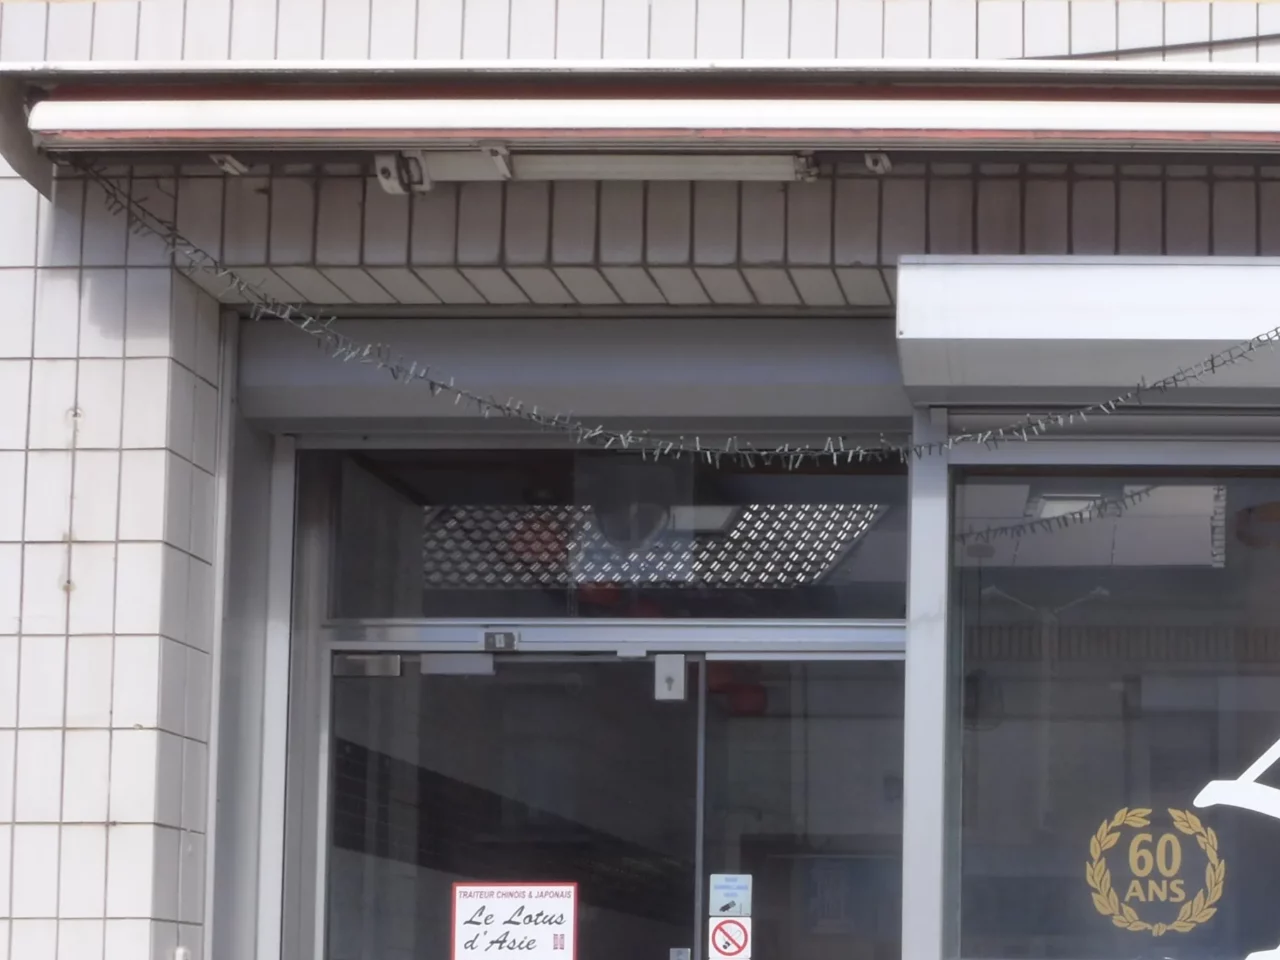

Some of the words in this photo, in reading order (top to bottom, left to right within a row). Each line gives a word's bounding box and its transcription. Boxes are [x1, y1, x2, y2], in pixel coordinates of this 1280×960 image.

[1129, 833, 1182, 878] 60
[459, 890, 494, 899] TRAITEUR
[496, 890, 526, 899] CHINOIS
[528, 891, 533, 899] &
[535, 890, 572, 899] JAPONAIS
[1124, 879, 1186, 903] ANS
[463, 905, 495, 926] Le
[502, 905, 566, 926] Lotus
[463, 931, 537, 952] d'Asie
